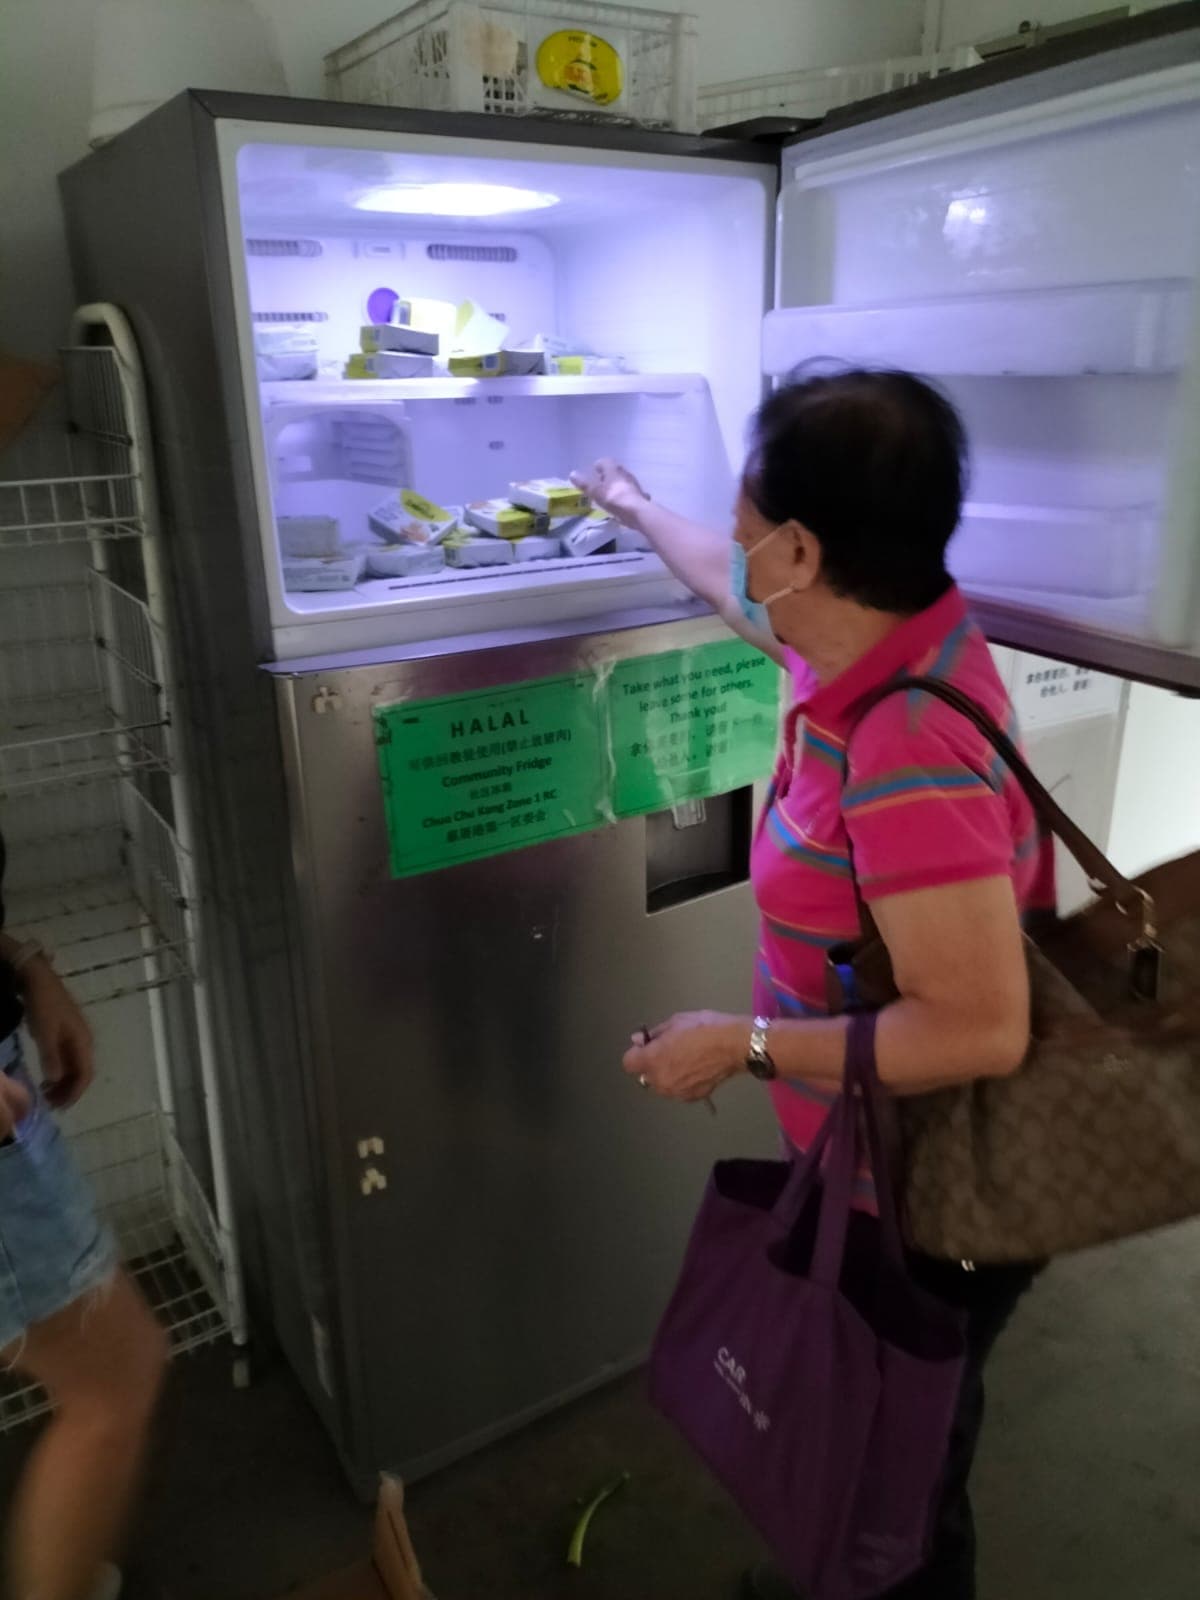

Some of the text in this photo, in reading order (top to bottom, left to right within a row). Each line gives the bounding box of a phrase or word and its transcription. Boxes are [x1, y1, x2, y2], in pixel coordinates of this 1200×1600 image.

[622, 681, 650, 696] Take
[653, 673, 679, 690] what
[735, 656, 767, 674] please
[701, 686, 718, 698] for
[450, 709, 530, 738] HALAL
[441, 755, 553, 788] Community Fridge
[543, 788, 558, 801] RC
